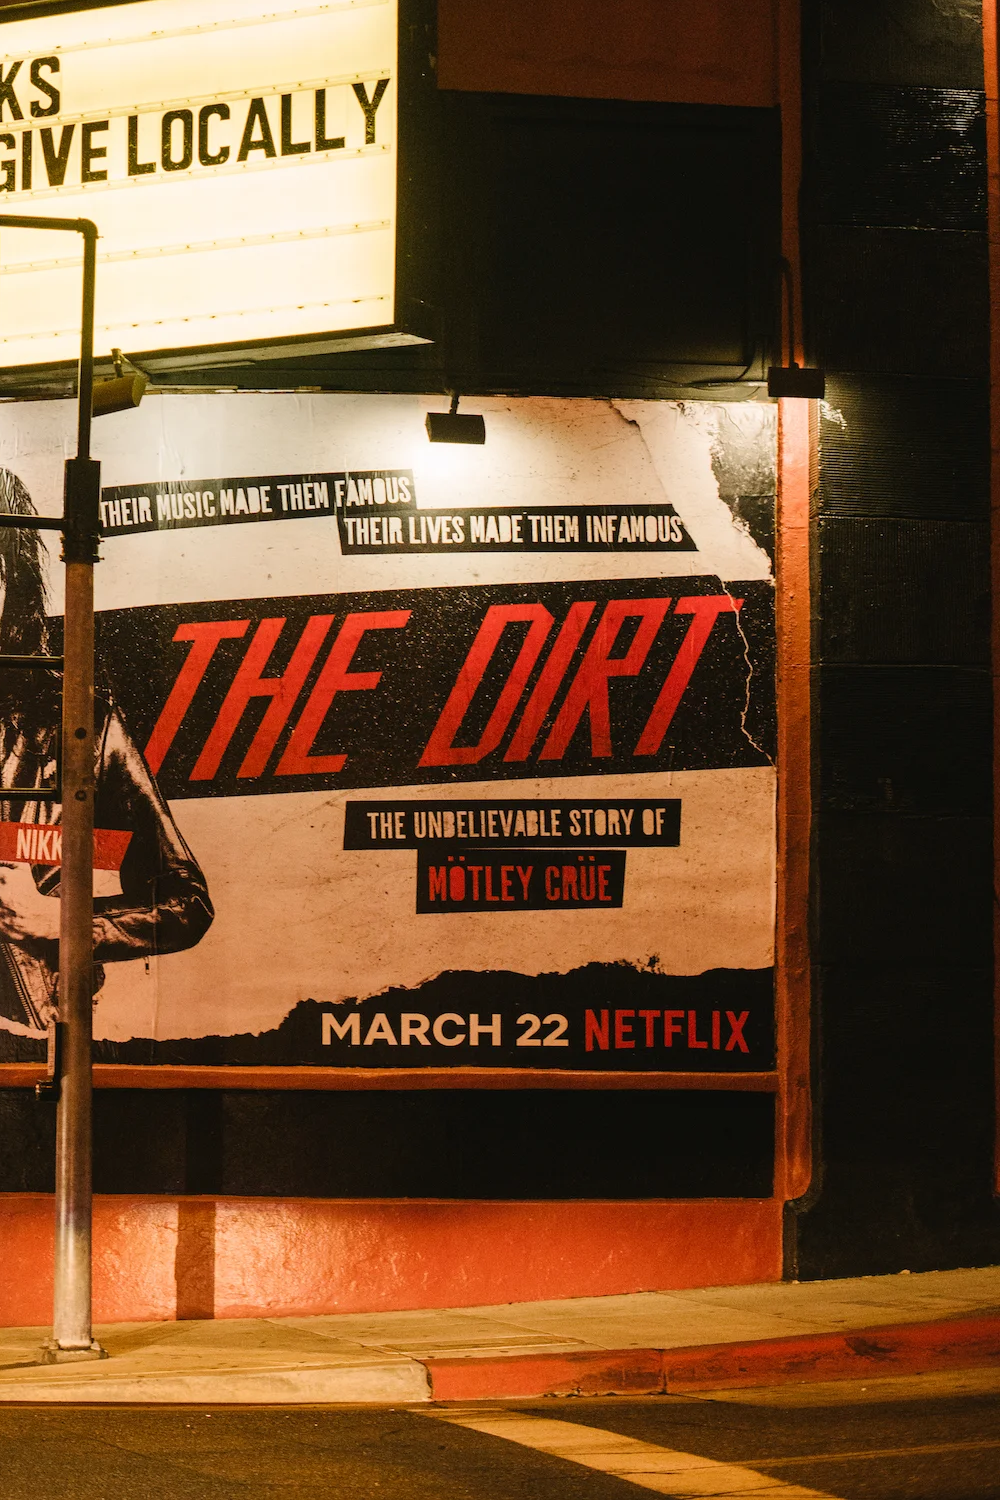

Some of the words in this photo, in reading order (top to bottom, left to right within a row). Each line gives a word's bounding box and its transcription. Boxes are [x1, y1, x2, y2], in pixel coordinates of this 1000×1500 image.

[127, 77, 391, 178] LOCALLY
[100, 496, 153, 529] THEIR
[156, 490, 216, 521] MUSIC
[220, 485, 273, 516] MADE
[276, 481, 329, 512] THEM
[334, 476, 413, 508] FAMOUS
[343, 516, 405, 546] THEIR
[409, 515, 465, 545] LIVES
[470, 514, 524, 544] MADE
[527, 514, 579, 543] THEM
[585, 514, 684, 544] INFAMOUS
[145, 608, 413, 783] THE
[417, 595, 745, 769] DIRT
[16, 827, 63, 861] NIKK
[366, 811, 406, 840] THE
[414, 809, 563, 839] UNBELIEVABLE
[569, 808, 635, 837] STORY
[642, 808, 667, 836] OF
[428, 855, 535, 902] MÖTLEY
[544, 855, 612, 902] CRÜE
[321, 1012, 502, 1047] MARCH
[515, 1012, 570, 1047] 22
[584, 1008, 751, 1055] NETFLIX
